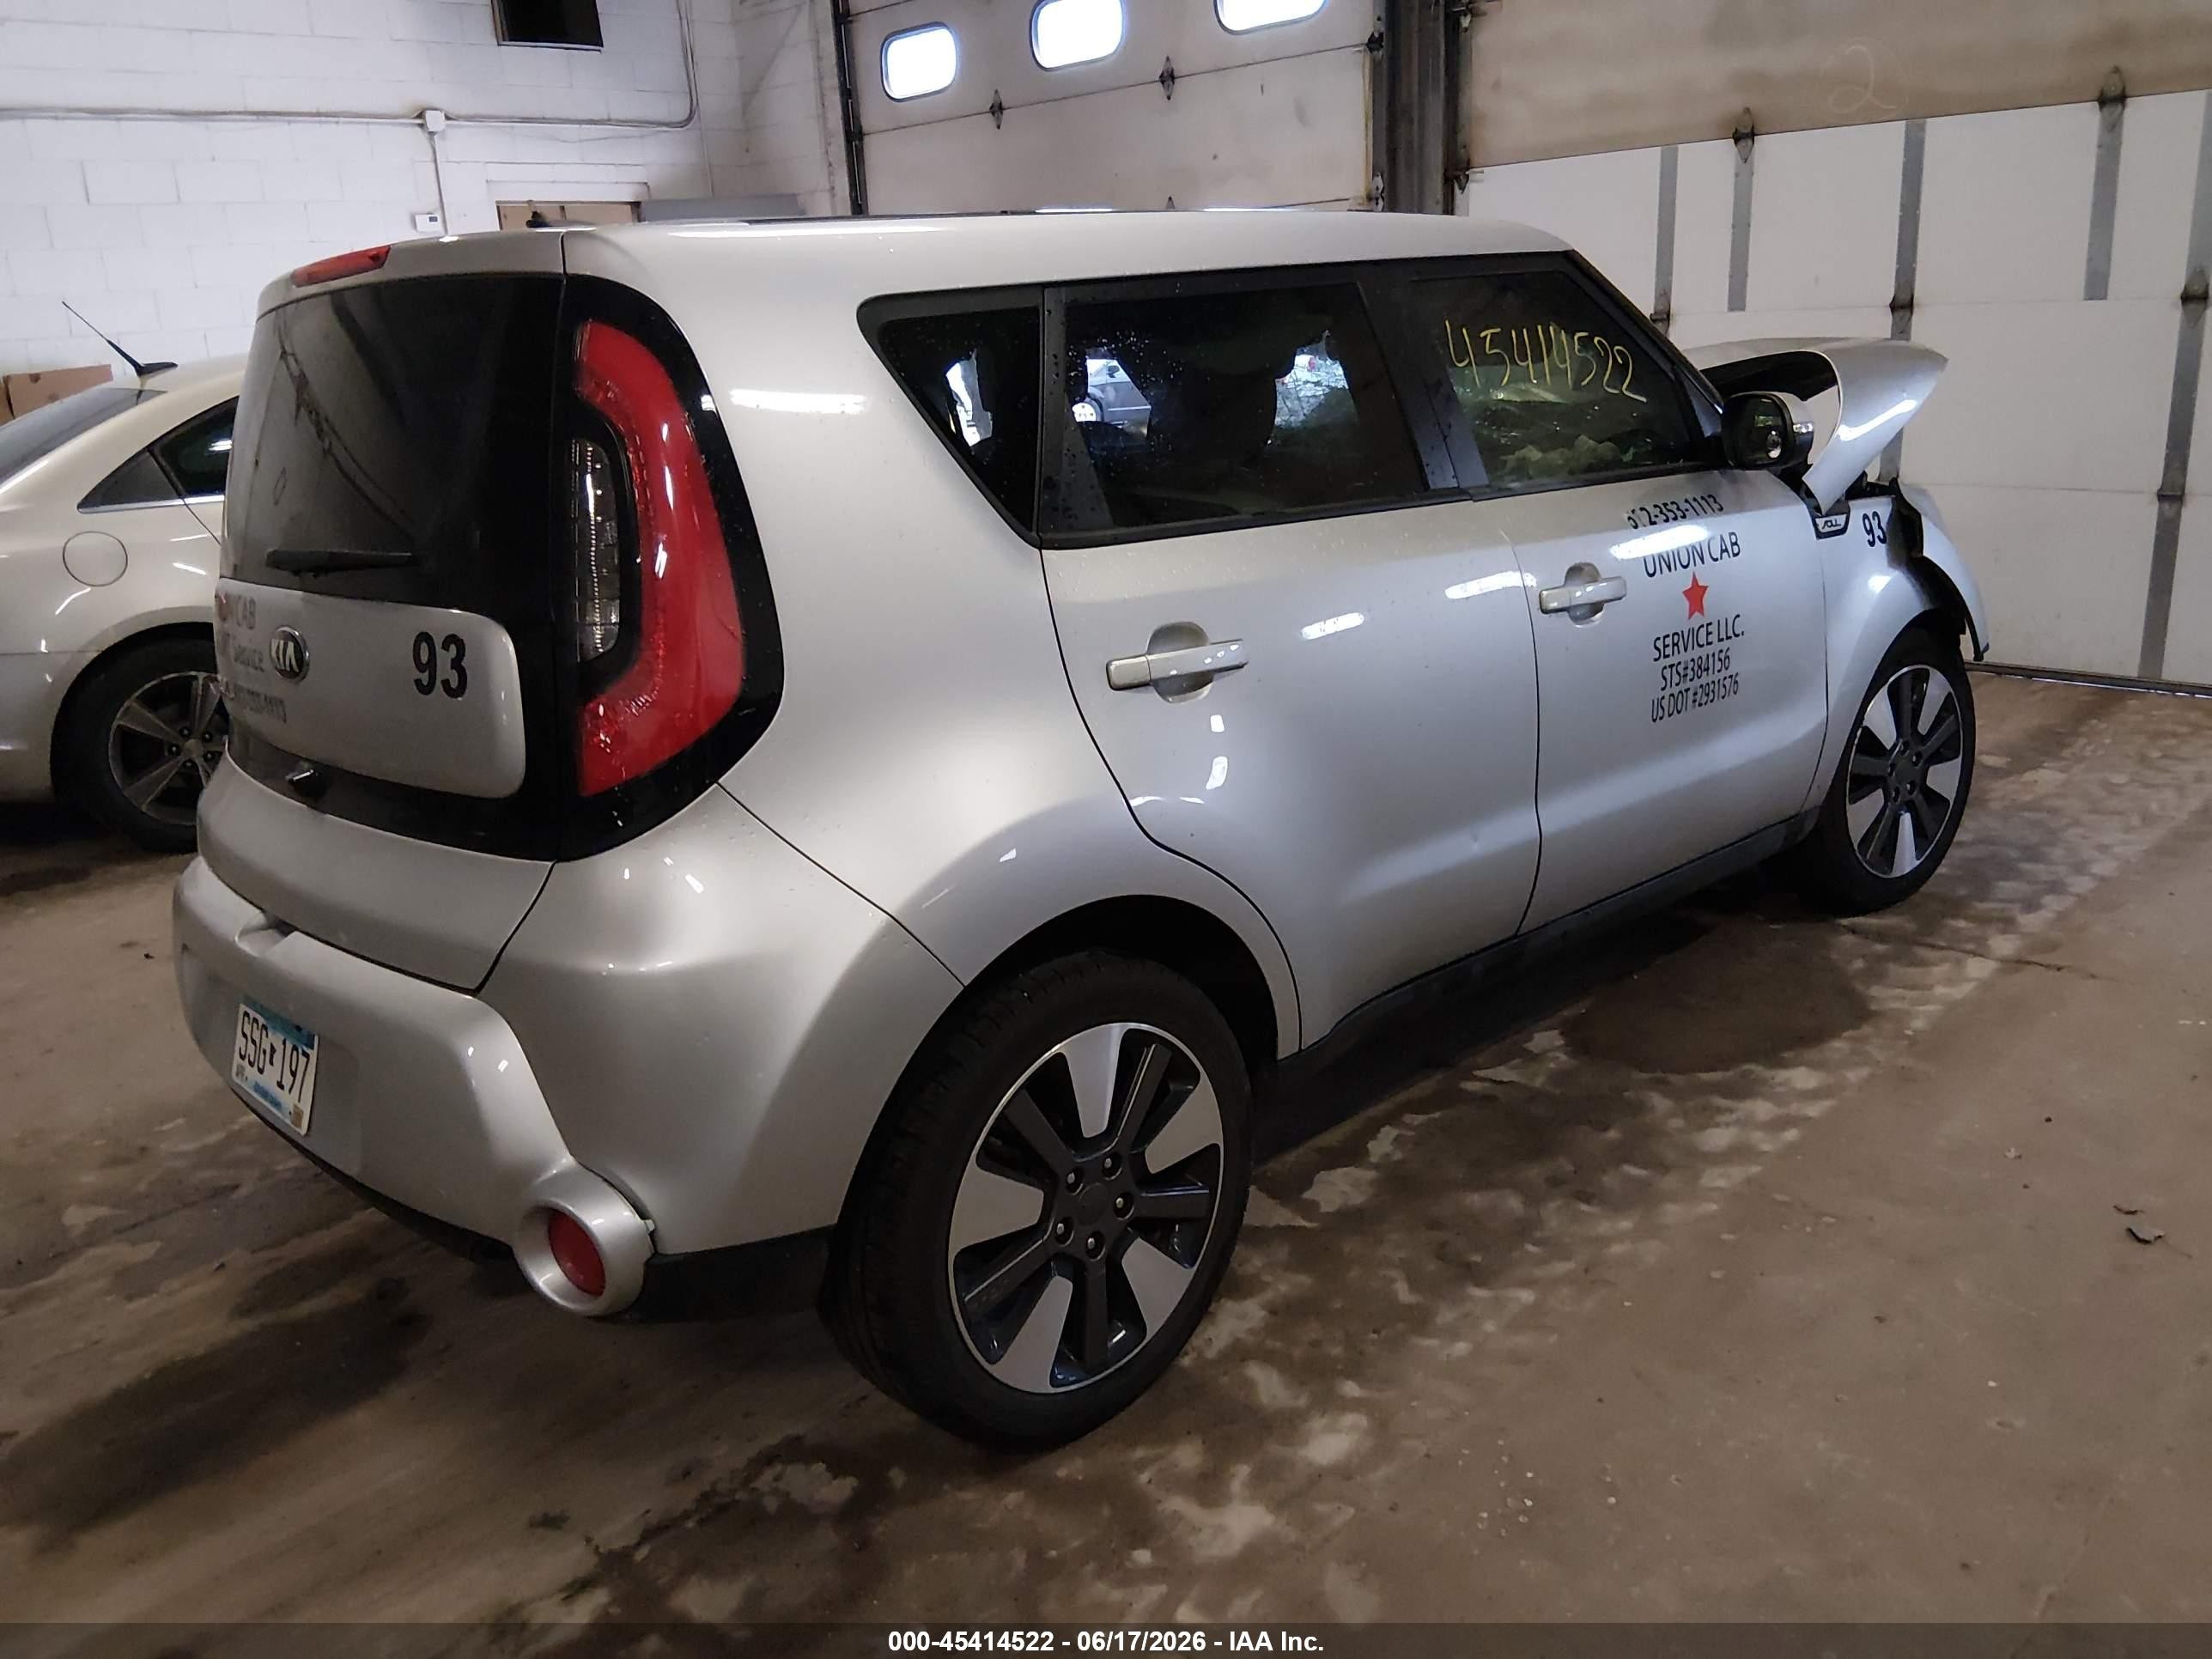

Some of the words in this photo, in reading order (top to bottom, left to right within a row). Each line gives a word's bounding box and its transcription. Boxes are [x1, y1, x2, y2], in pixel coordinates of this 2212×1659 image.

[1444, 319, 1648, 404] 45414522
[1862, 510, 1887, 548] 93
[1643, 539, 1705, 578] UNION
[1706, 532, 1741, 563] CAB
[271, 638, 300, 673] KIA
[1653, 622, 1713, 662] SERVICE
[1717, 613, 1746, 644] LLC.
[412, 631, 469, 700] 93
[1660, 646, 1731, 691] STS#384156
[1667, 689, 1690, 719] DOT
